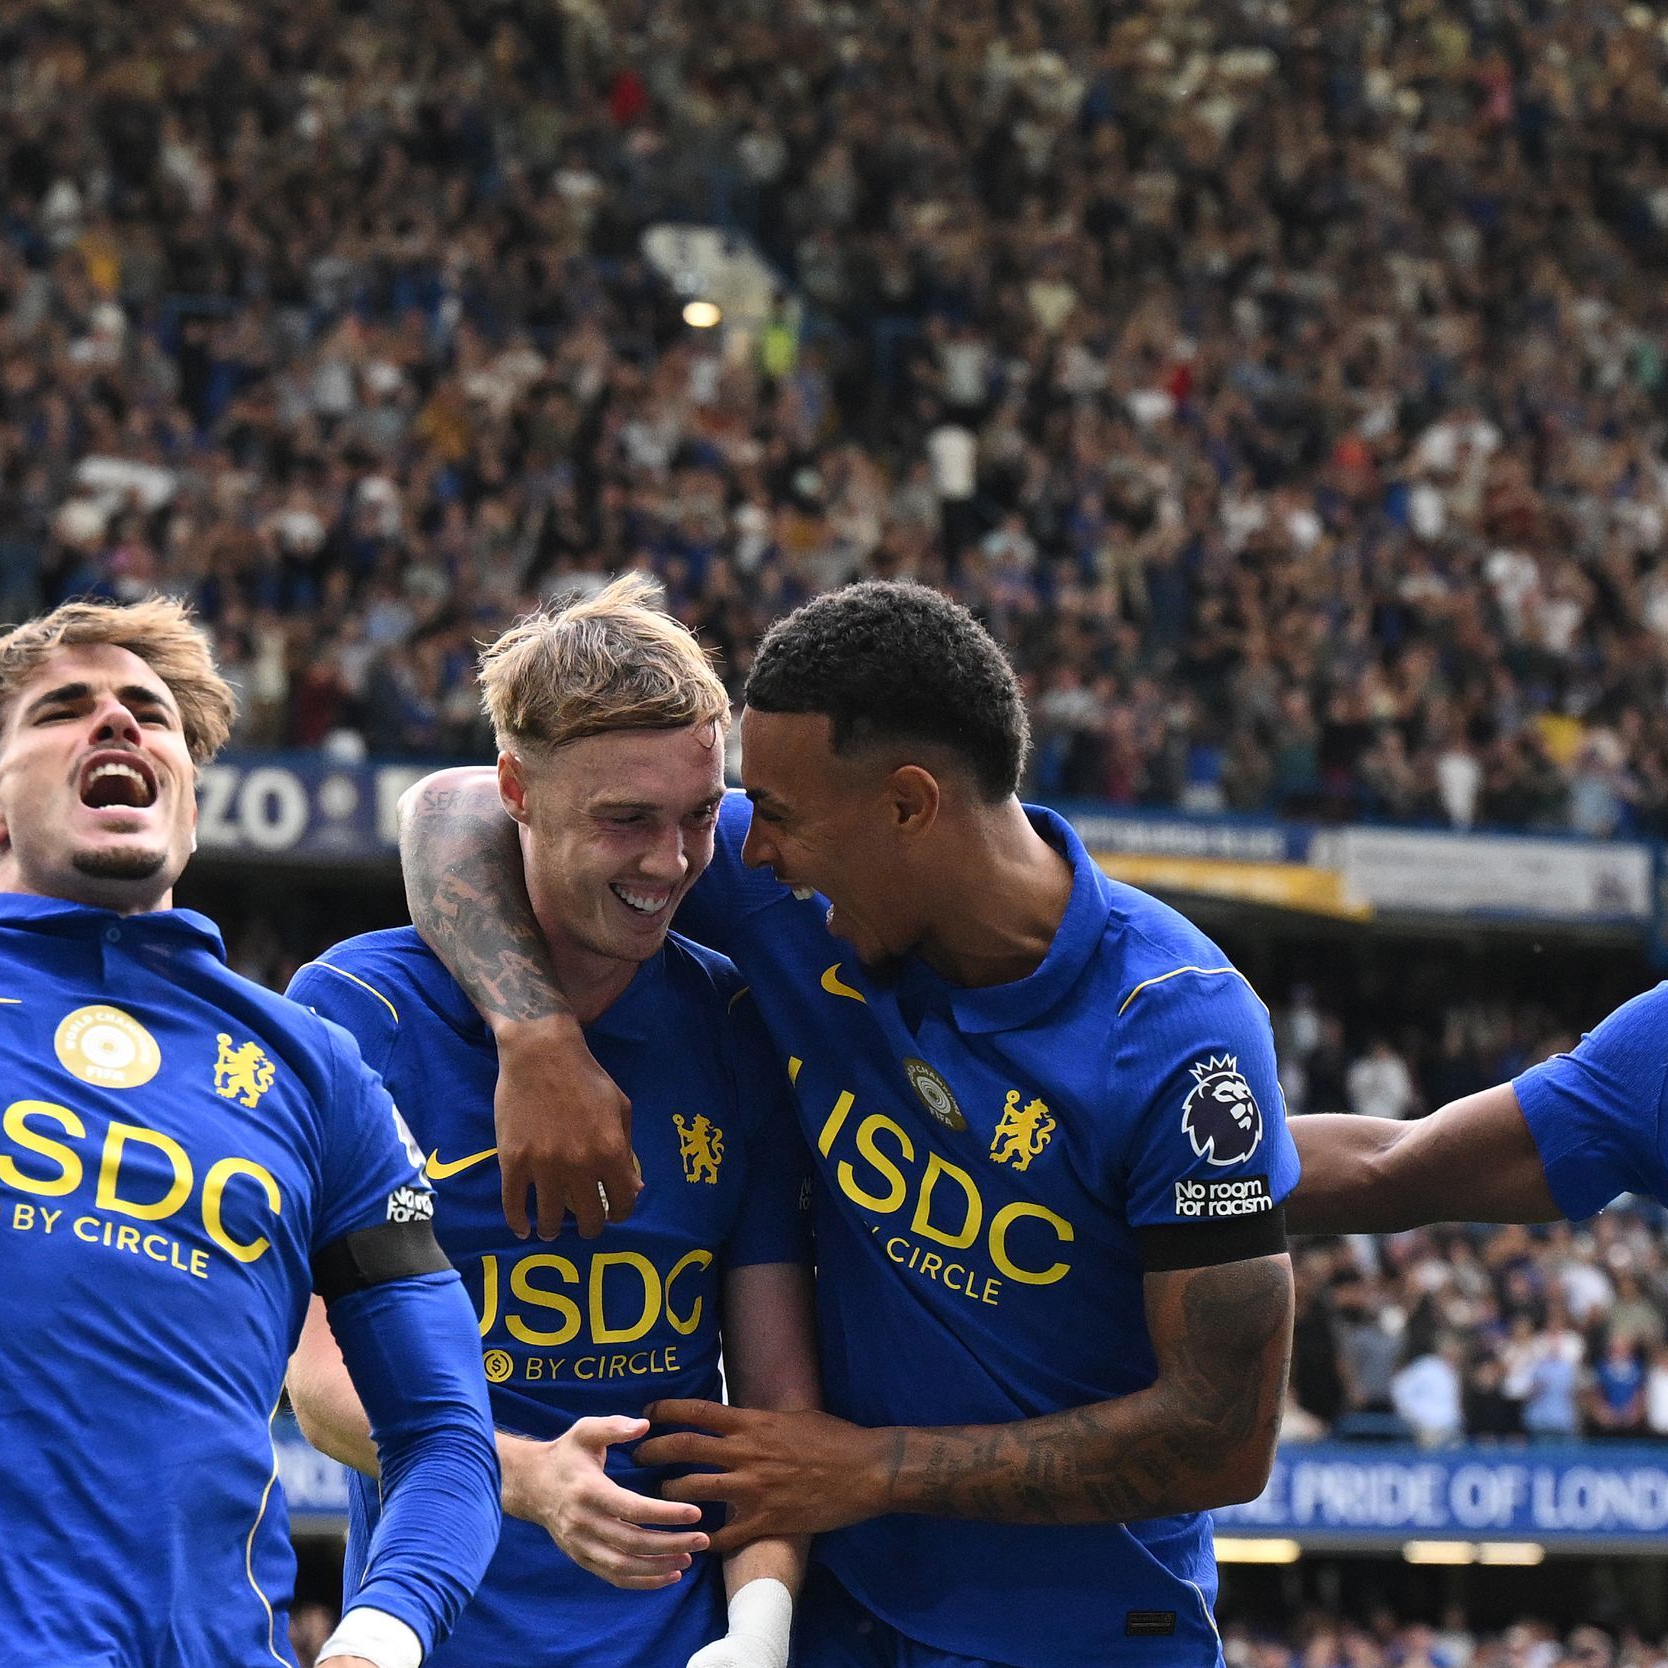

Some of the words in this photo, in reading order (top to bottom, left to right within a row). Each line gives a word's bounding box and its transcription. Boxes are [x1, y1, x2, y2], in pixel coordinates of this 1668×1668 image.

[1175, 1180, 1206, 1199] No
[1209, 1179, 1262, 1199] room
[1175, 1197, 1205, 1217] for
[1209, 1195, 1273, 1217] racism
[13, 1202, 62, 1234] BY
[73, 1215, 210, 1280] CIRCLE
[885, 1236, 1003, 1306] CIRCLE
[525, 1356, 567, 1381] BY
[573, 1346, 681, 1379] CIRCLE
[1289, 1461, 1451, 1527] PRIDE
[1450, 1462, 1523, 1528] OF
